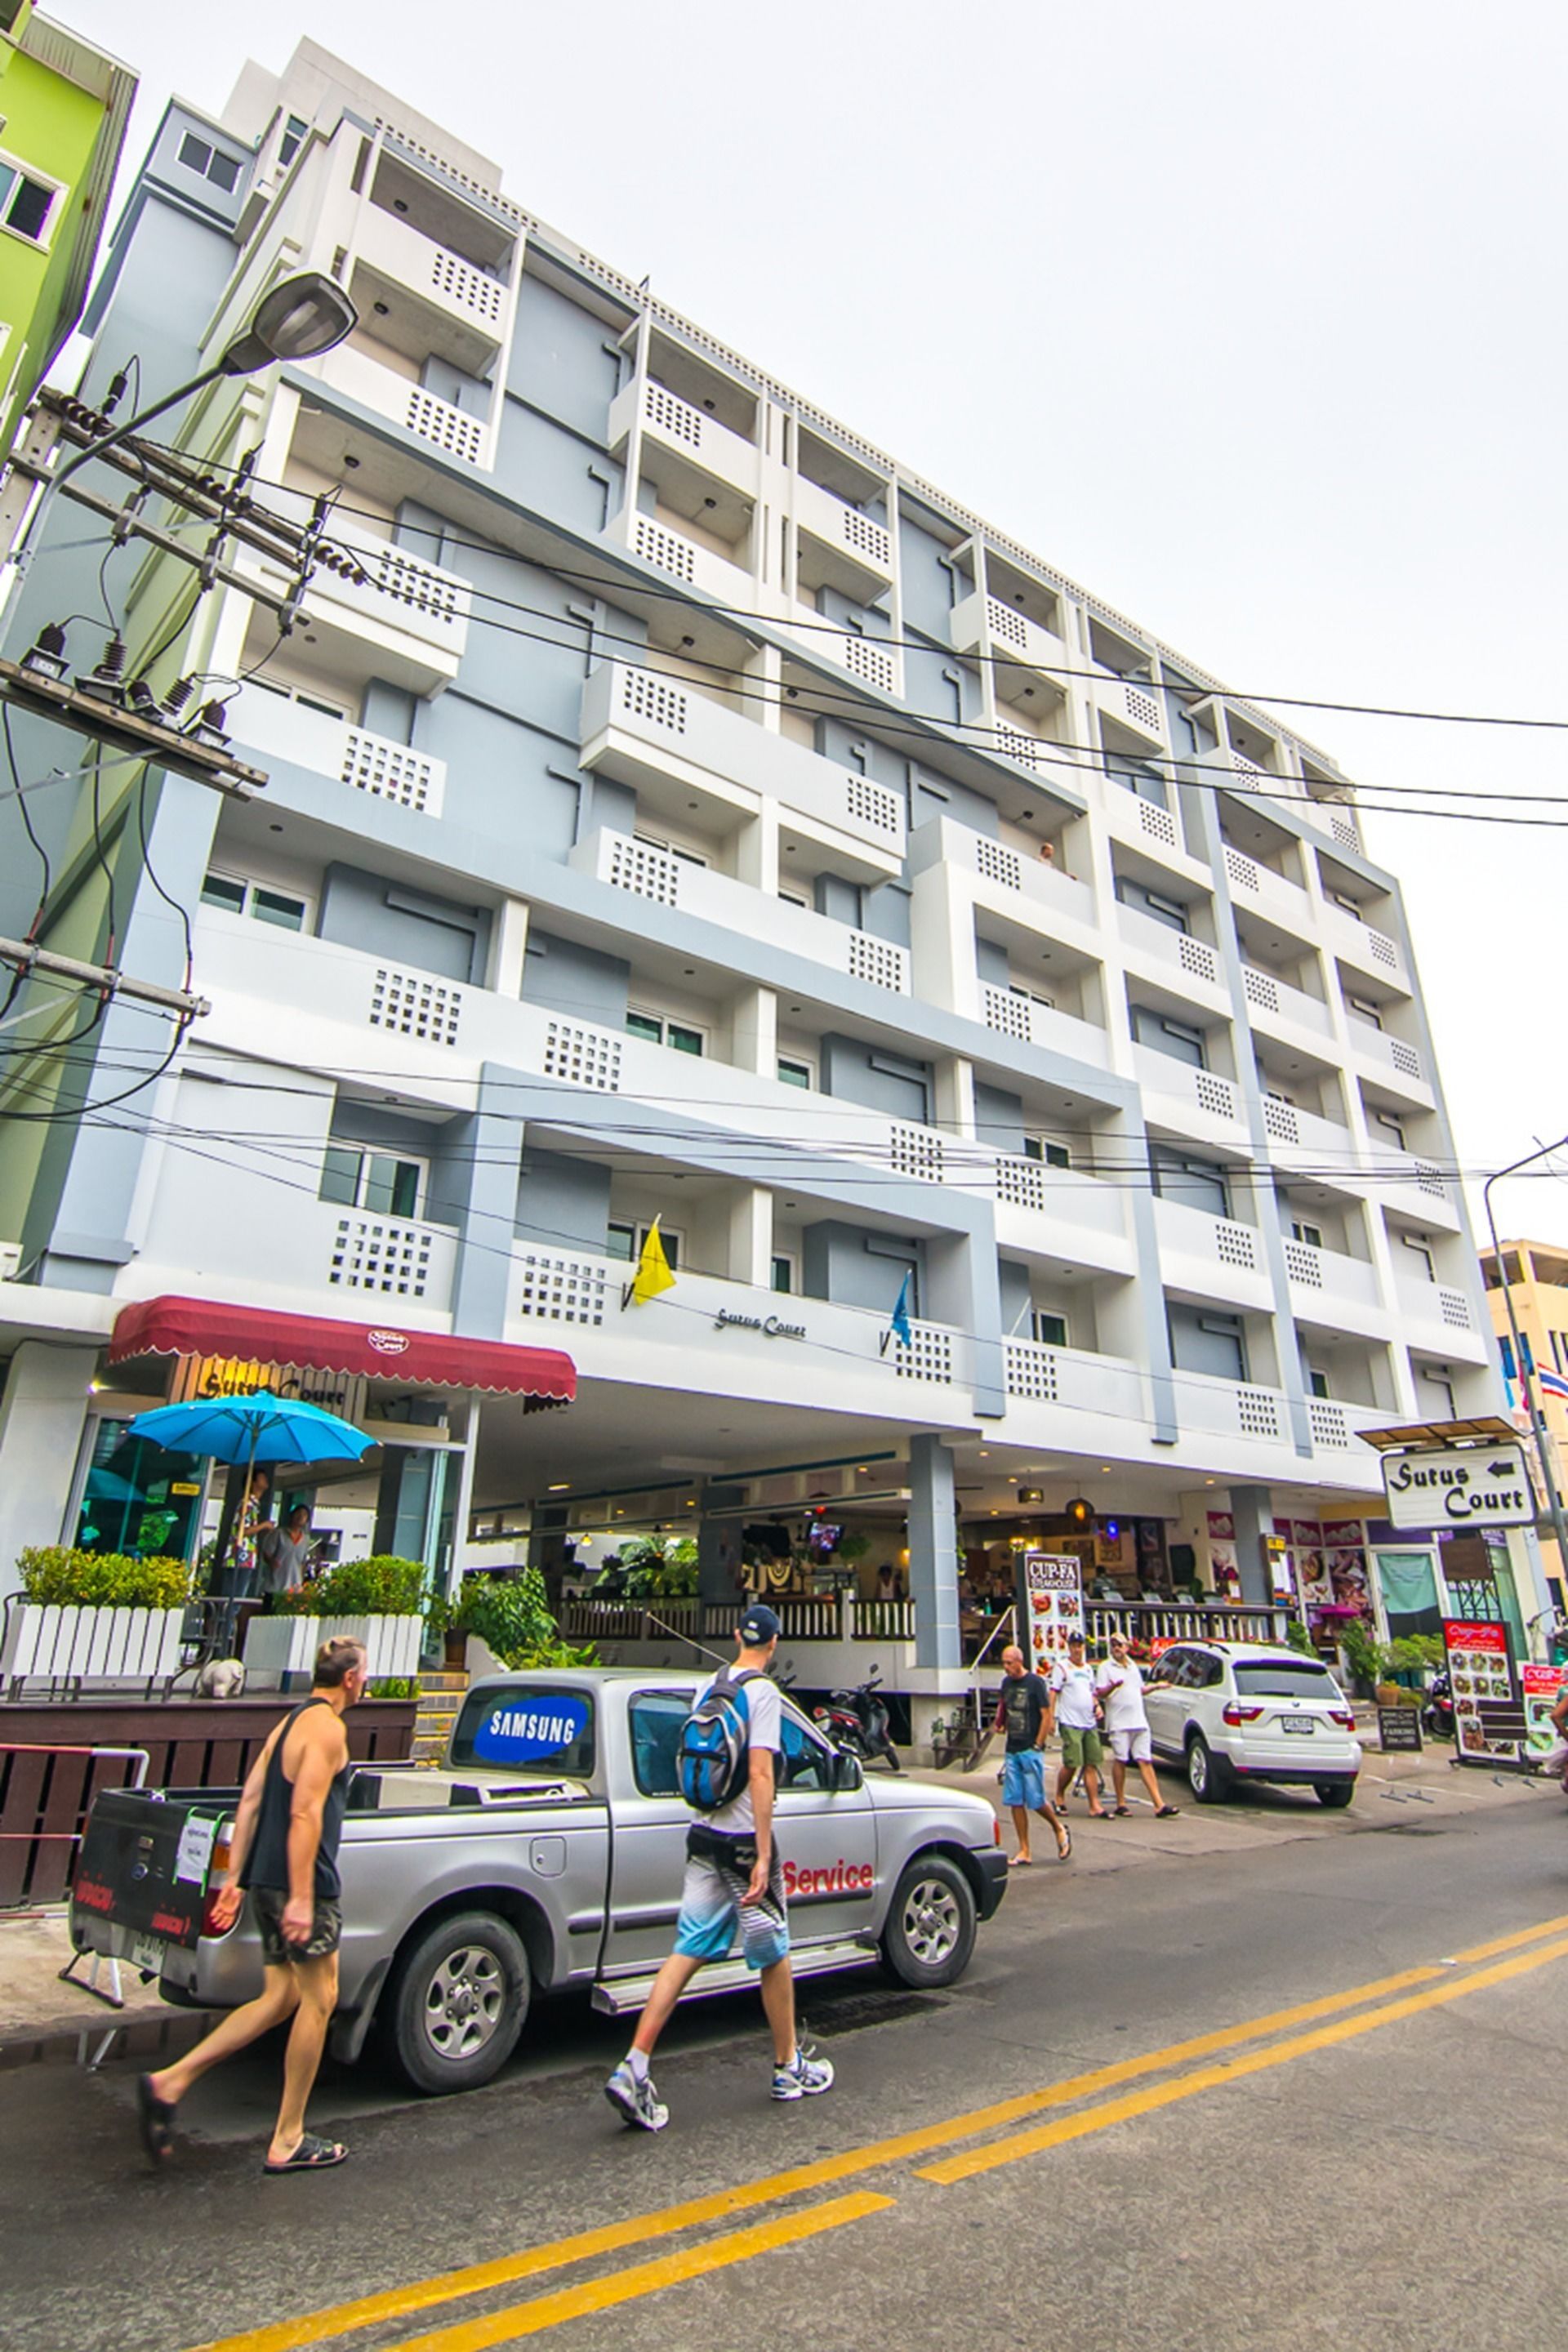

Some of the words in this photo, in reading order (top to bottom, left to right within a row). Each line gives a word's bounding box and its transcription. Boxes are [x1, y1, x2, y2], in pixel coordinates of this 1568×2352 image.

[1389, 1463, 1469, 1491] Sutus
[1445, 1487, 1522, 1517] Court
[1030, 1561, 1076, 1579] CUP-FA
[490, 1710, 575, 1745] SAMSUNG
[782, 1858, 873, 1895] Service
